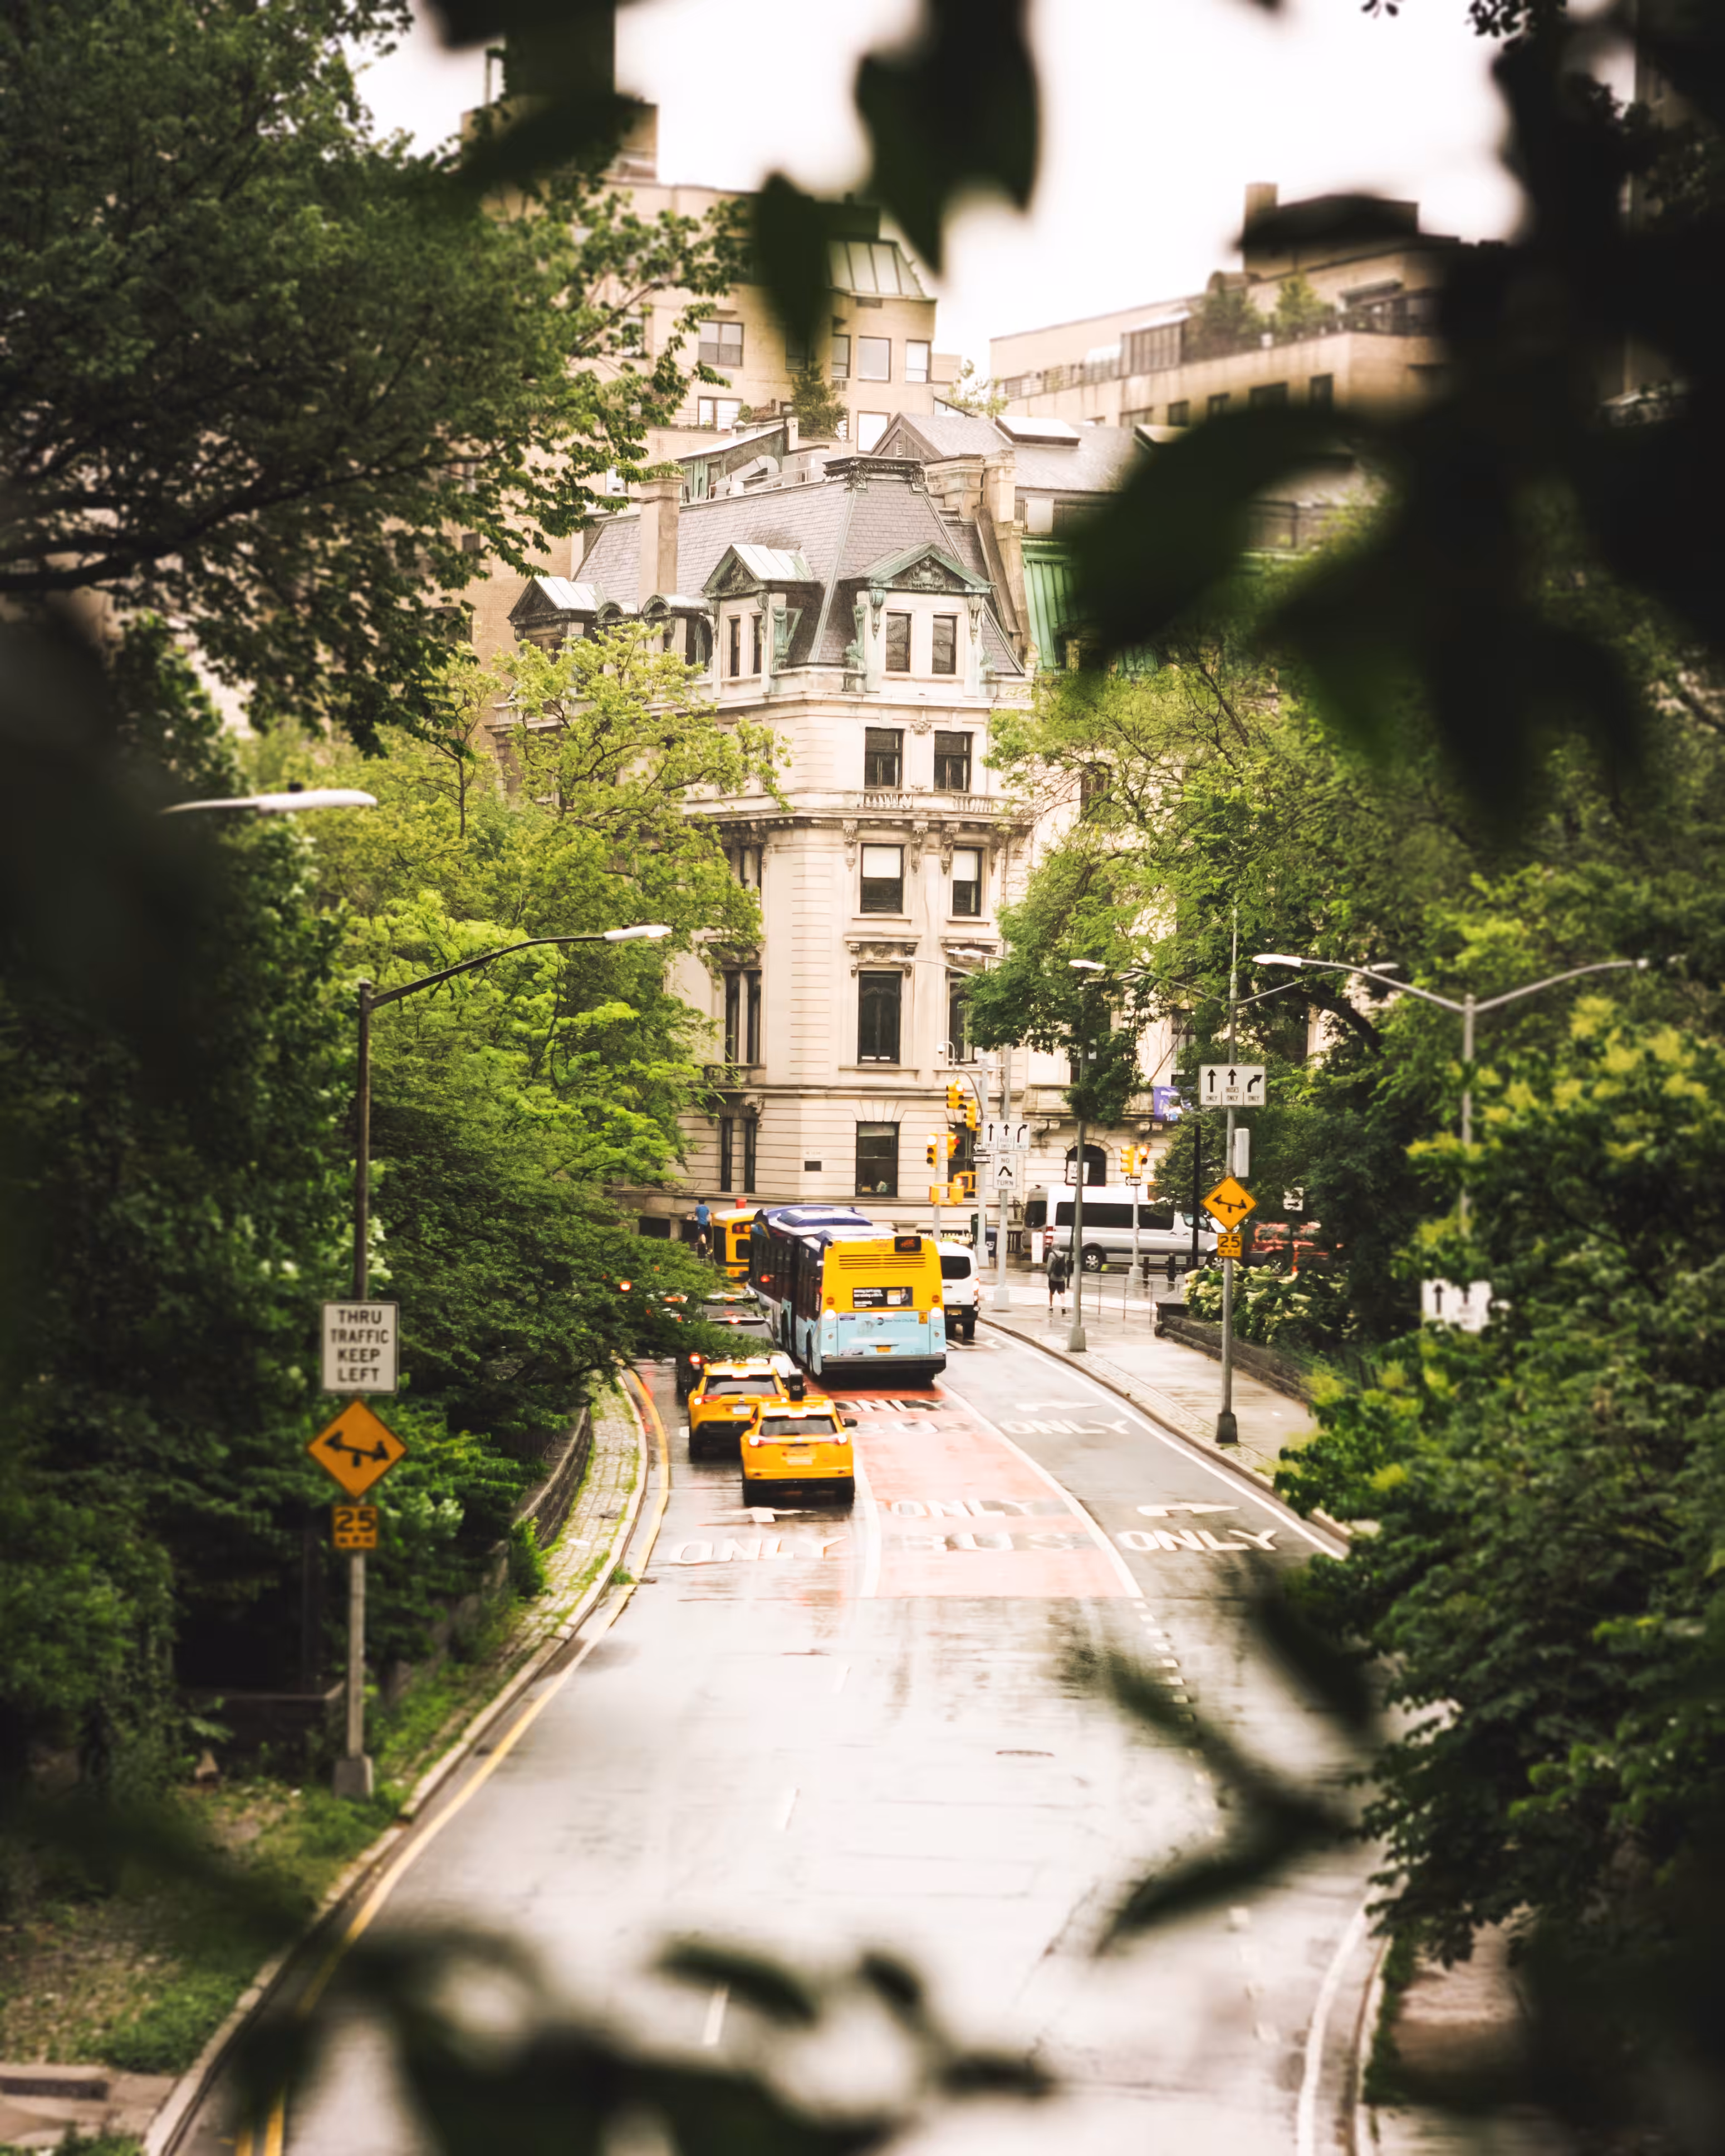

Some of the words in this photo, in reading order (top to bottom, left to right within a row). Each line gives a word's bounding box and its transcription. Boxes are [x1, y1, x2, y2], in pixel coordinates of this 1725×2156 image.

[1220, 1236, 1239, 1248] 25
[338, 1310, 381, 1324] THRU
[331, 1329, 389, 1344] TRAFFIC
[338, 1349, 380, 1363] KEEP
[338, 1368, 379, 1382] LEFT
[834, 1400, 945, 1412] ONLY
[1000, 1420, 1130, 1434] ONLY
[891, 1500, 1034, 1517] ONLY
[336, 1510, 376, 1532] 25
[1118, 1530, 1277, 1551] ONLY
[669, 1536, 847, 1564] ONLY
